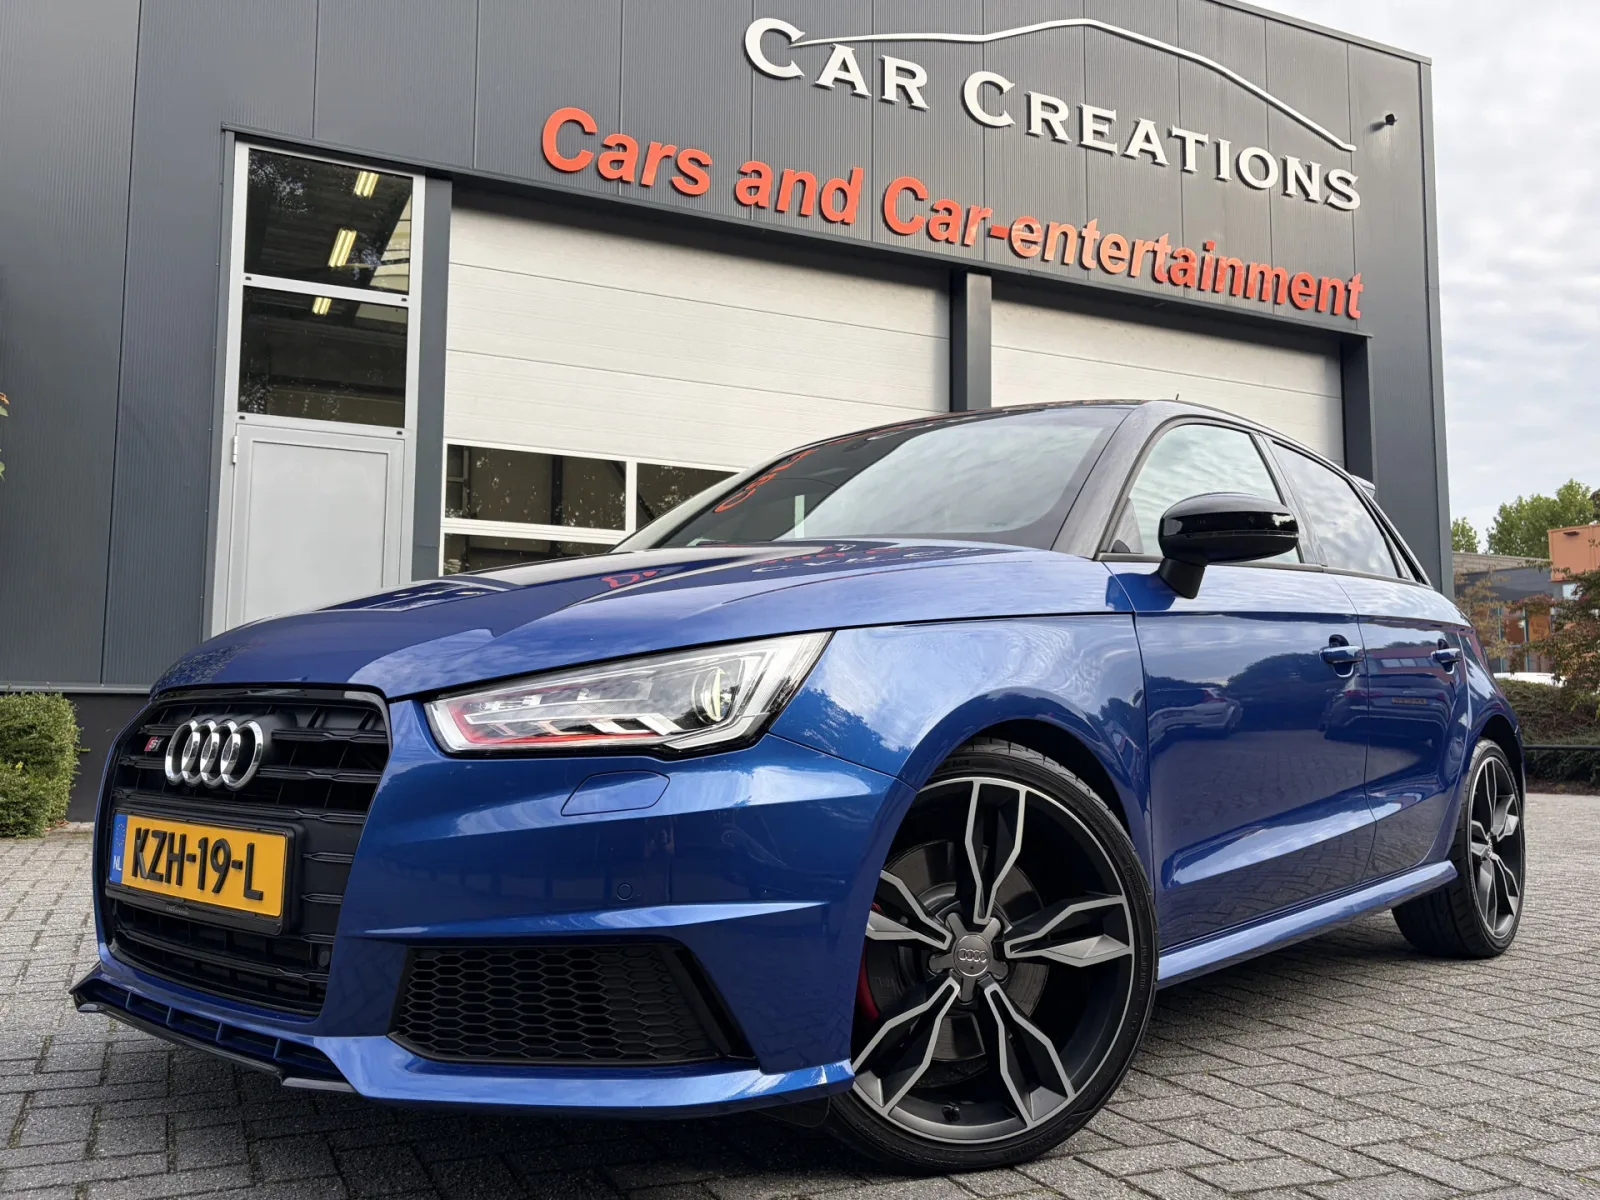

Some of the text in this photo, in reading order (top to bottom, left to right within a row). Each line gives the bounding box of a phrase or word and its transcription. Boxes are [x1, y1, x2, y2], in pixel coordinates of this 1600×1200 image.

[744, 17, 1361, 210] CAR CREATIONS
[541, 106, 1364, 319] Cars and Car-entertainment
[113, 855, 122, 871] NL
[131, 827, 264, 901] KZH-19-L
